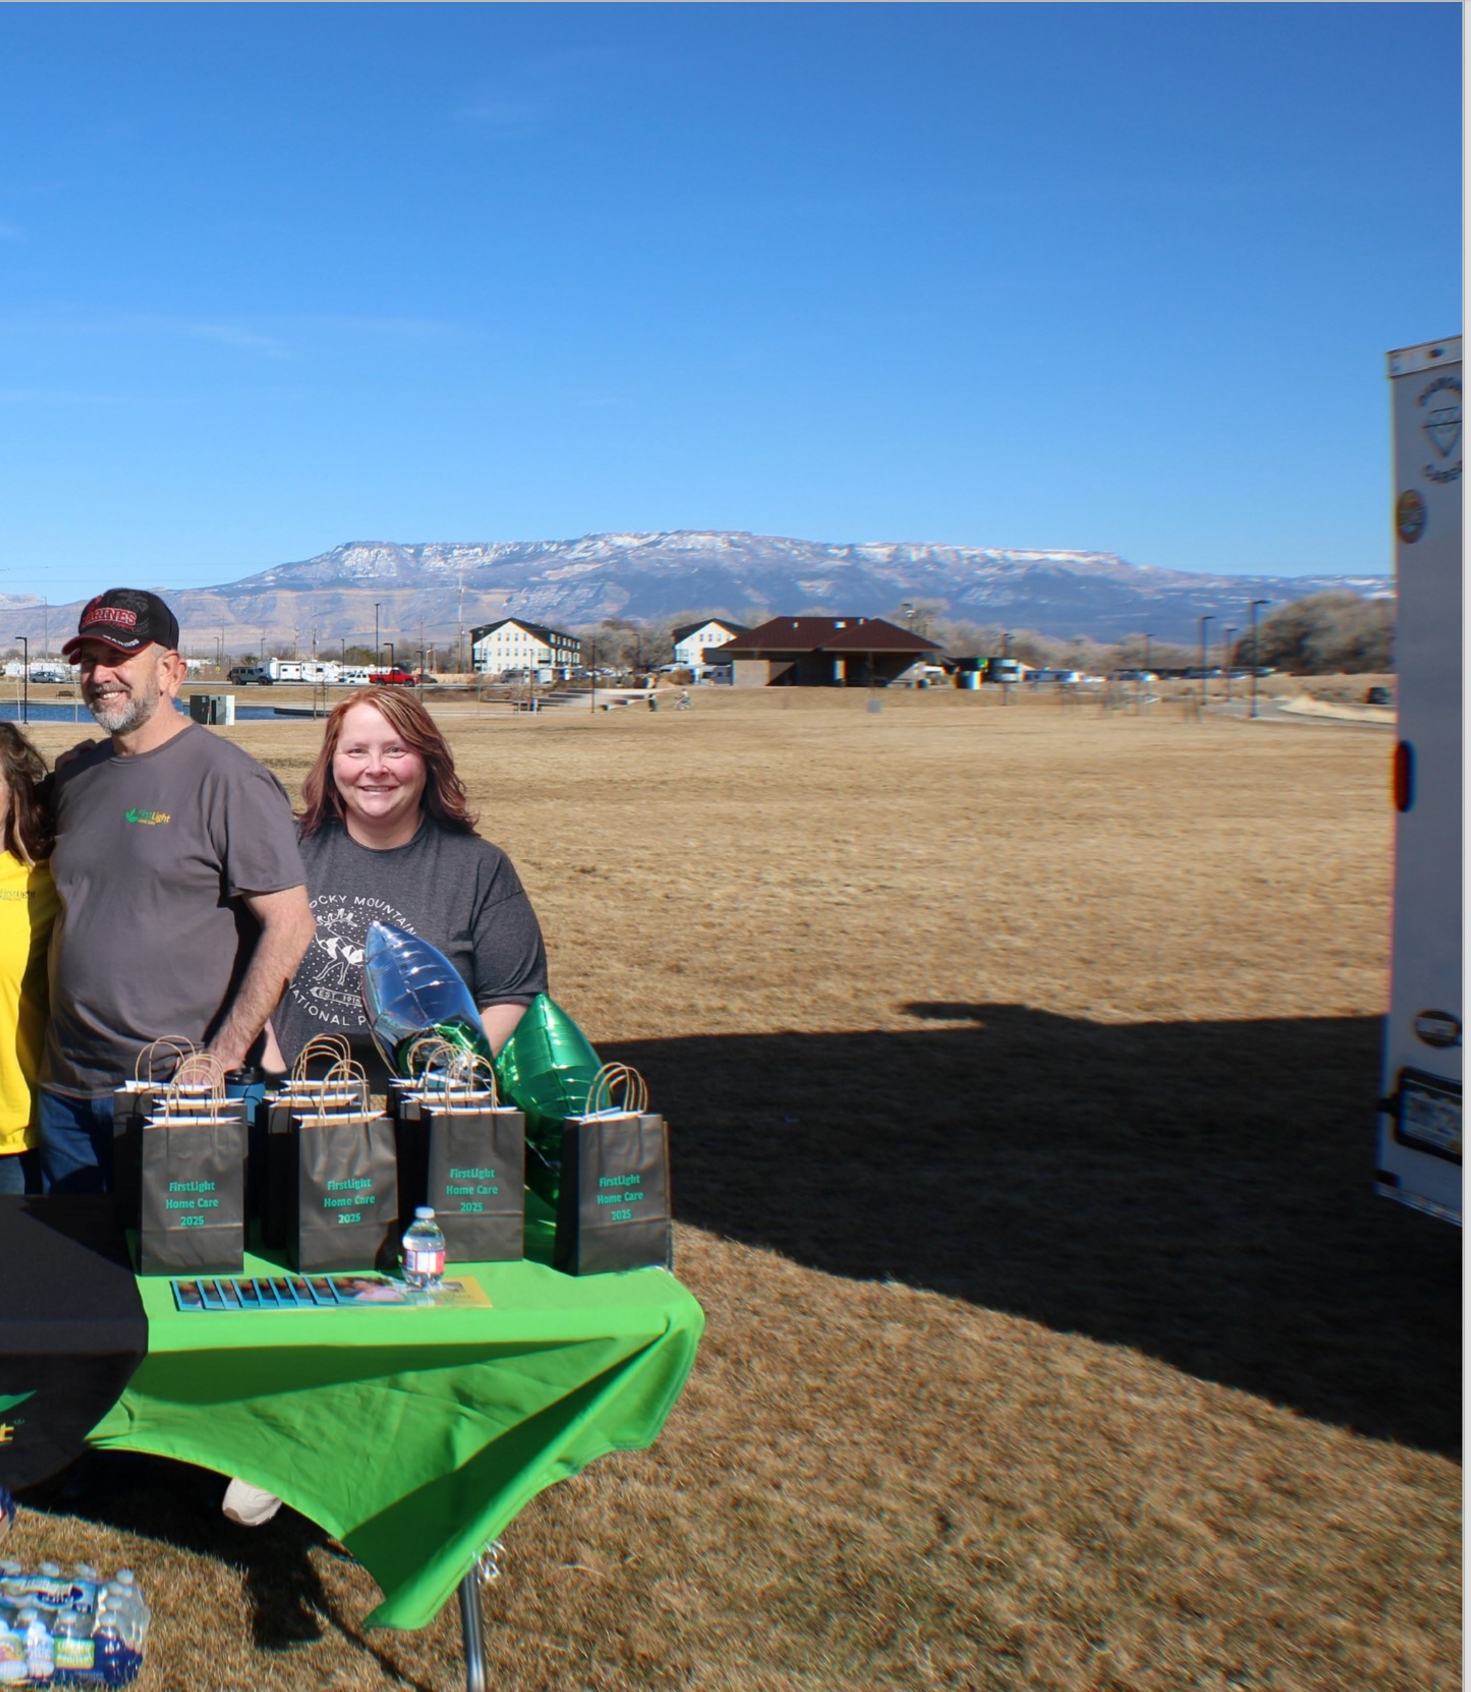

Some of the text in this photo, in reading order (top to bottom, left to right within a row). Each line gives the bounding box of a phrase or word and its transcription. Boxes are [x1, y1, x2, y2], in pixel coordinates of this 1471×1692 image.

[308, 895, 347, 909] OCKY
[450, 1168, 495, 1180] FirstLight
[168, 1180, 216, 1193] FirstLight
[327, 1178, 372, 1191] FirstLight
[599, 1174, 641, 1188] FirstLight
[446, 1185, 499, 1195] Home Care
[165, 1198, 220, 1210] Home Care
[324, 1194, 376, 1208] Home Care
[597, 1191, 644, 1205] Home Care
[460, 1202, 484, 1212] 2025
[180, 1216, 205, 1227] 2025
[338, 1213, 361, 1224] 2025
[611, 1210, 632, 1221] 2025
